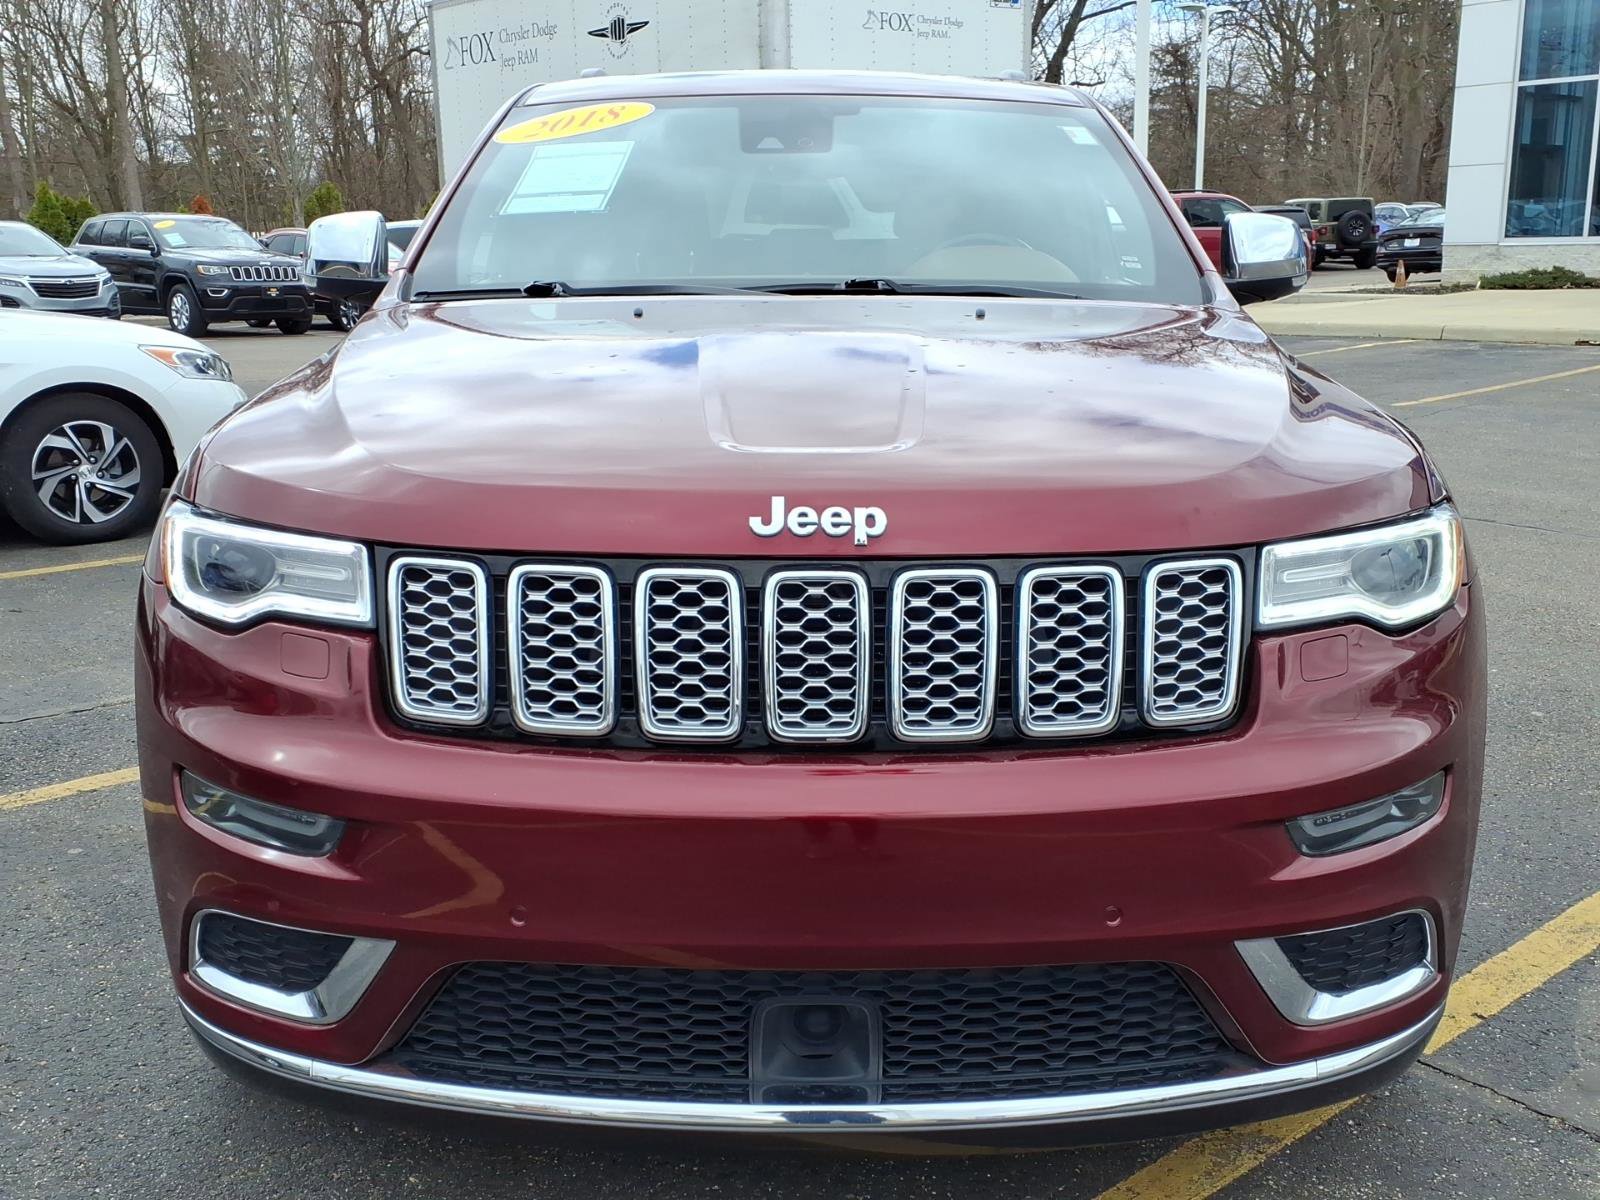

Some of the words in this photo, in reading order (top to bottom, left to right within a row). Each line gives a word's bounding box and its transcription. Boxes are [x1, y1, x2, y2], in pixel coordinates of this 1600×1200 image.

[499, 24, 530, 46] Chrysler
[532, 20, 558, 40] Dodge
[880, 11, 913, 32] FOX
[917, 28, 930, 40] Jeep
[930, 29, 948, 38] RAM
[459, 31, 496, 66] FOX
[500, 53, 516, 71] Jeep
[517, 47, 538, 65] RAM
[524, 105, 627, 138] 2018
[749, 495, 888, 546] Jeep
